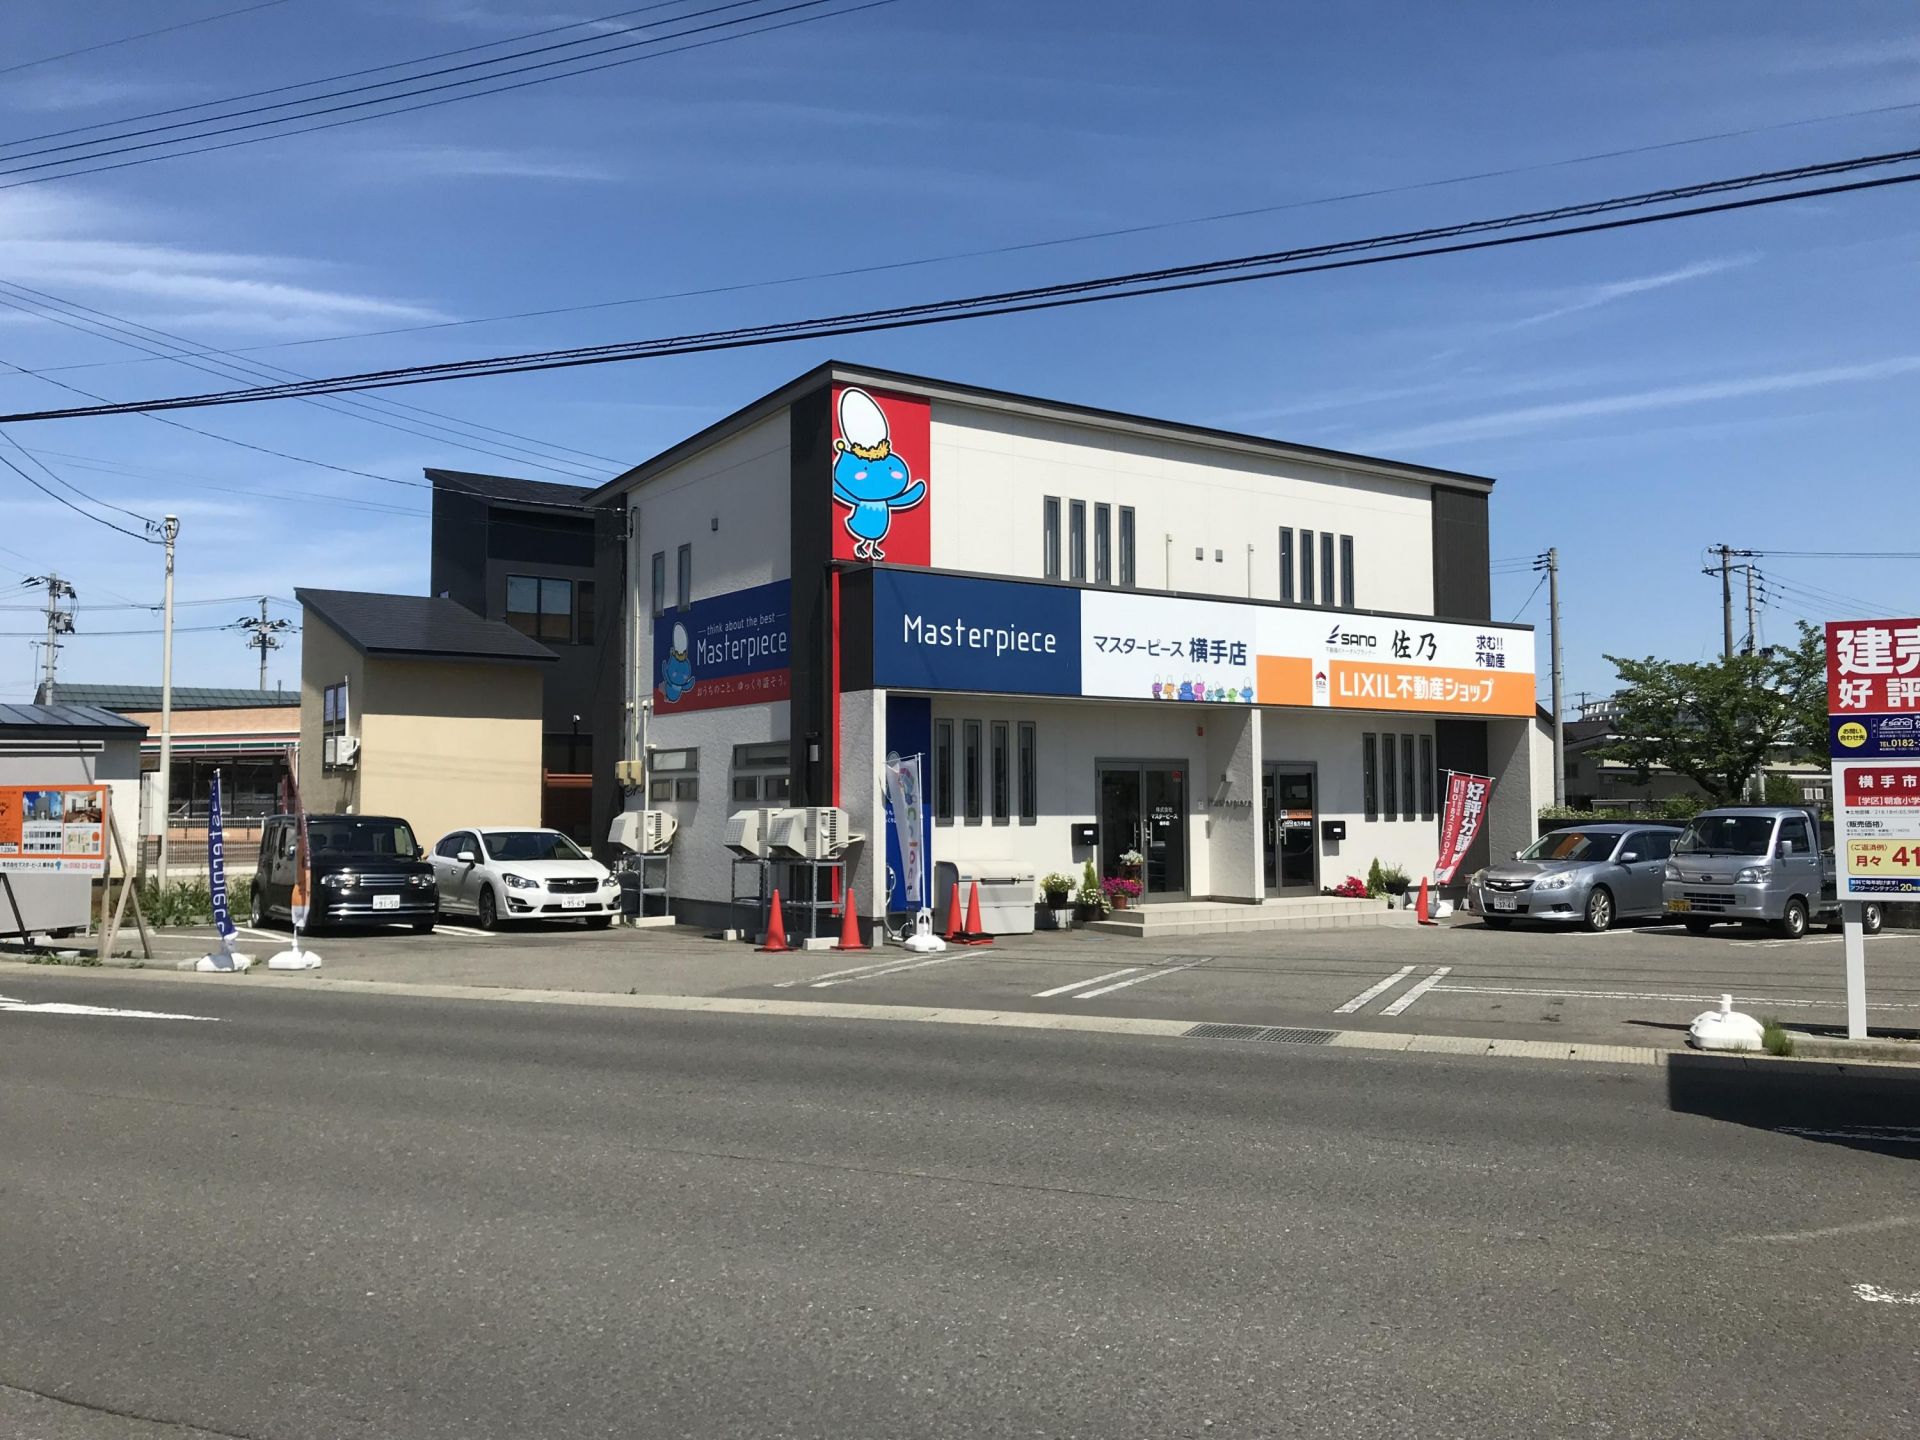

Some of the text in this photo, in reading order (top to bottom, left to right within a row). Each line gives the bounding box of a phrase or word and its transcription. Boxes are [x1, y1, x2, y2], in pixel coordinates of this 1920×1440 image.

[707, 612, 776, 635] think about the best
[904, 613, 1057, 657] Masterpiece
[696, 627, 788, 667] Masterpiece
[1093, 635, 1248, 667] マスターピース 横手店
[1391, 629, 1438, 661] 佐乃
[1475, 652, 1506, 669] 不動産
[1339, 671, 1494, 703] LIXIL不動産ショップ
[1856, 855, 1882, 867] 月々
